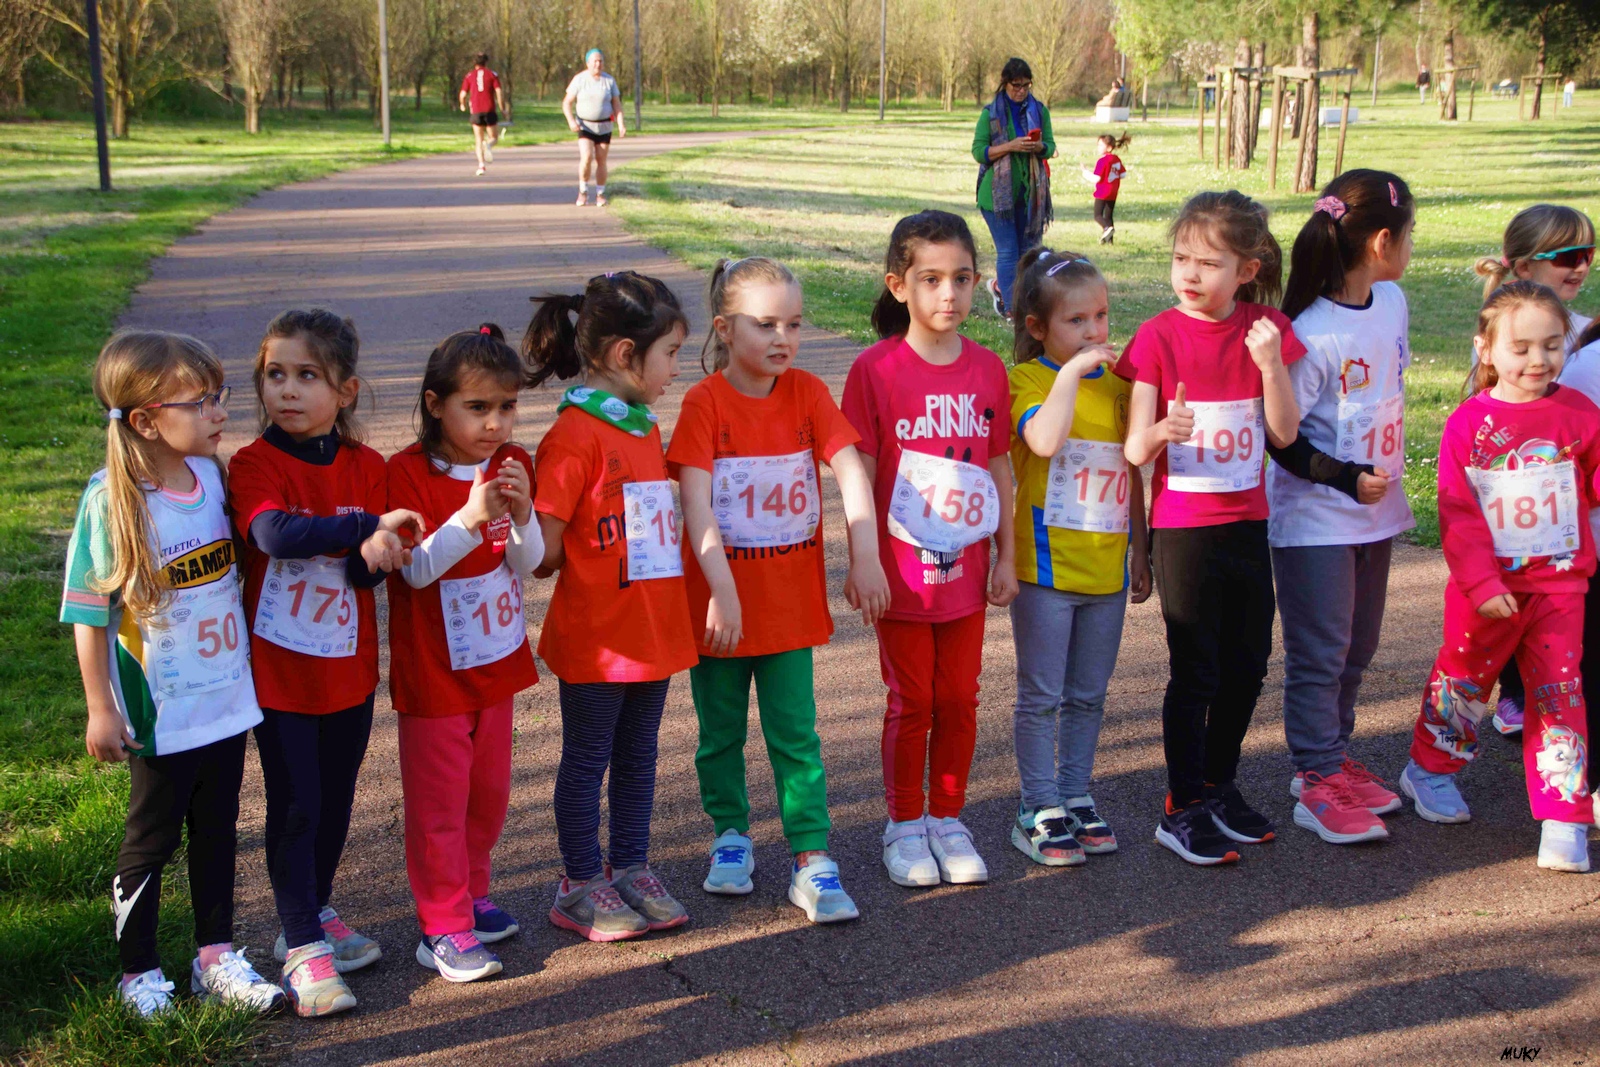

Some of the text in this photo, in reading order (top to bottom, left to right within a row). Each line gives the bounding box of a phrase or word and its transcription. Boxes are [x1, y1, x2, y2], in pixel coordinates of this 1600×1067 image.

[924, 394, 977, 417] PINK
[1190, 426, 1253, 464] 199
[738, 480, 807, 519] 146
[1073, 466, 1127, 505] 170
[919, 484, 985, 527] 158
[1488, 492, 1559, 530] 181
[487, 528, 508, 541] LOC
[651, 508, 679, 547] 19
[161, 537, 202, 558] TLETICA
[923, 568, 947, 585] sulle
[287, 579, 351, 627] 175
[472, 578, 522, 637] 183
[197, 611, 239, 660] 50
